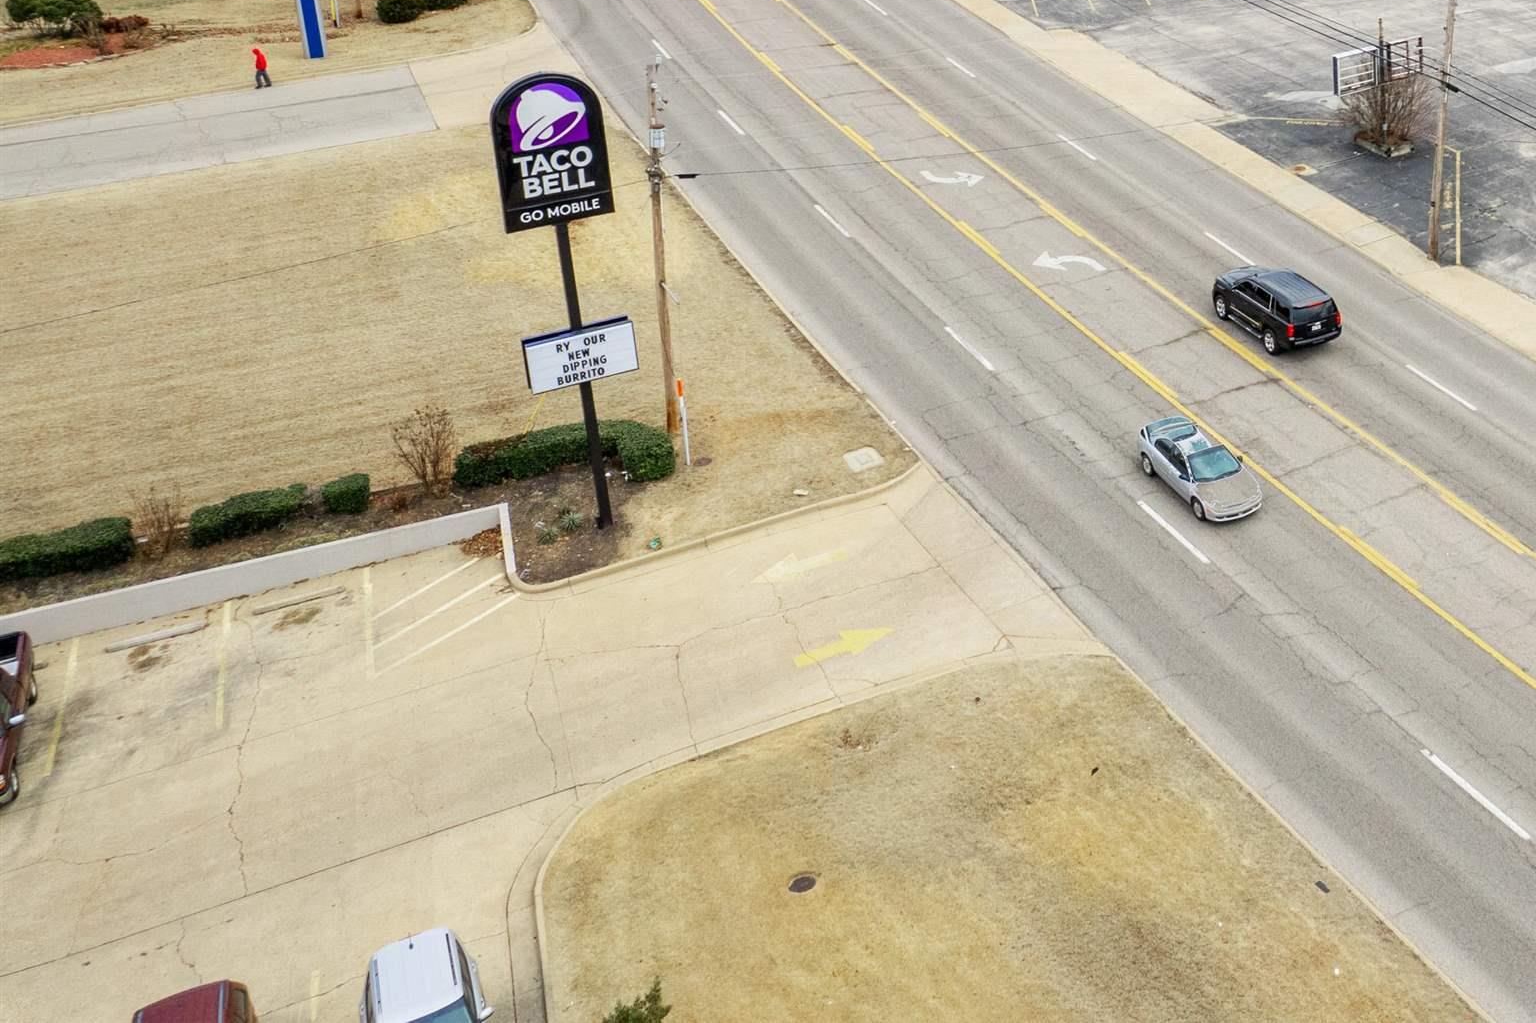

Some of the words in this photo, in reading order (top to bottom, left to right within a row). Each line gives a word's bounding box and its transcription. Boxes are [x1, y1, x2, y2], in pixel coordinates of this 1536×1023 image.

[513, 146, 593, 178] TACO
[522, 169, 596, 199] BELL
[520, 209, 544, 224] GO
[546, 198, 600, 218] MOBILE
[556, 343, 571, 354] RY
[583, 334, 606, 347] OUR
[562, 355, 608, 374] DIPPING
[568, 348, 591, 361] NEW
[556, 367, 605, 386] BURRITO
